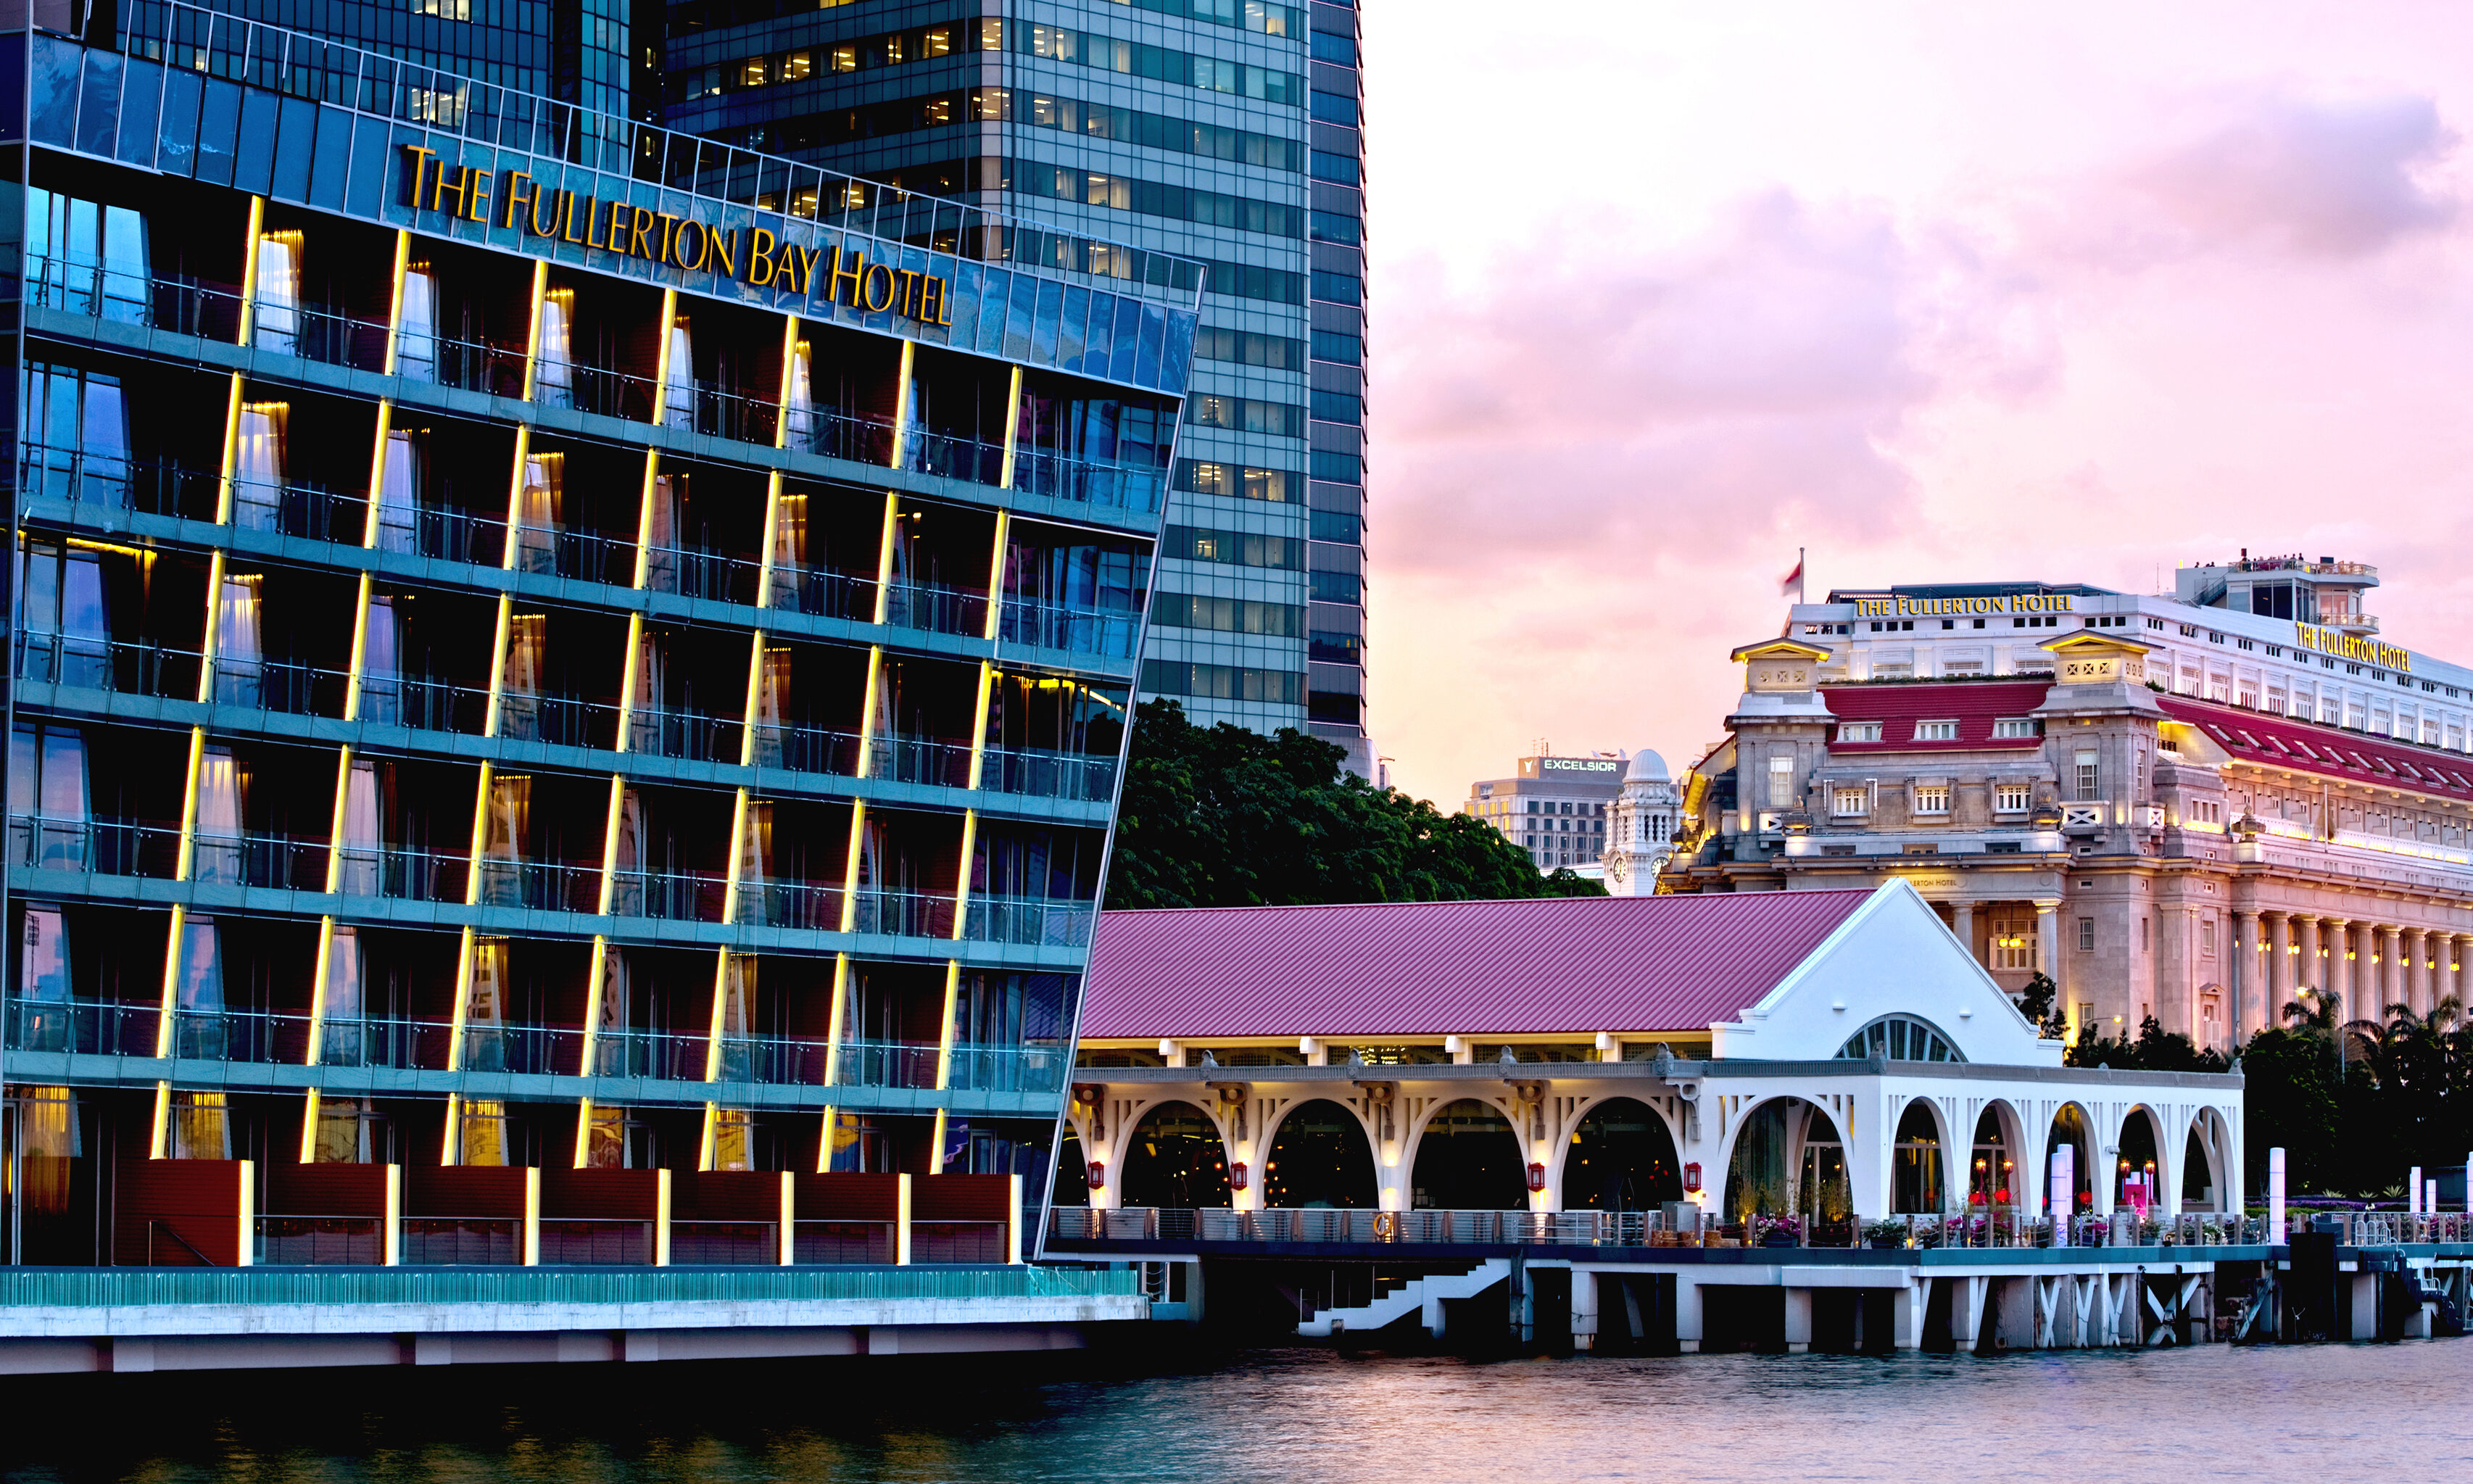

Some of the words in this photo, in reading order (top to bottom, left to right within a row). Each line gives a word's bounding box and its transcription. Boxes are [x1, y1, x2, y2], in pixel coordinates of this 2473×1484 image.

[404, 144, 493, 223] THE
[502, 170, 737, 278] FULLERTON
[747, 226, 821, 294] BAY
[826, 245, 952, 326] HOTEL
[1855, 599, 1890, 615] THE
[1897, 596, 2005, 615] FULLERTON
[2013, 594, 2074, 612] HOTEL
[2297, 621, 2316, 650] THE
[2319, 627, 2376, 664] FULLERTON
[2379, 642, 2411, 672] HOTEL
[1544, 759, 1617, 772] EXCELSIOR
